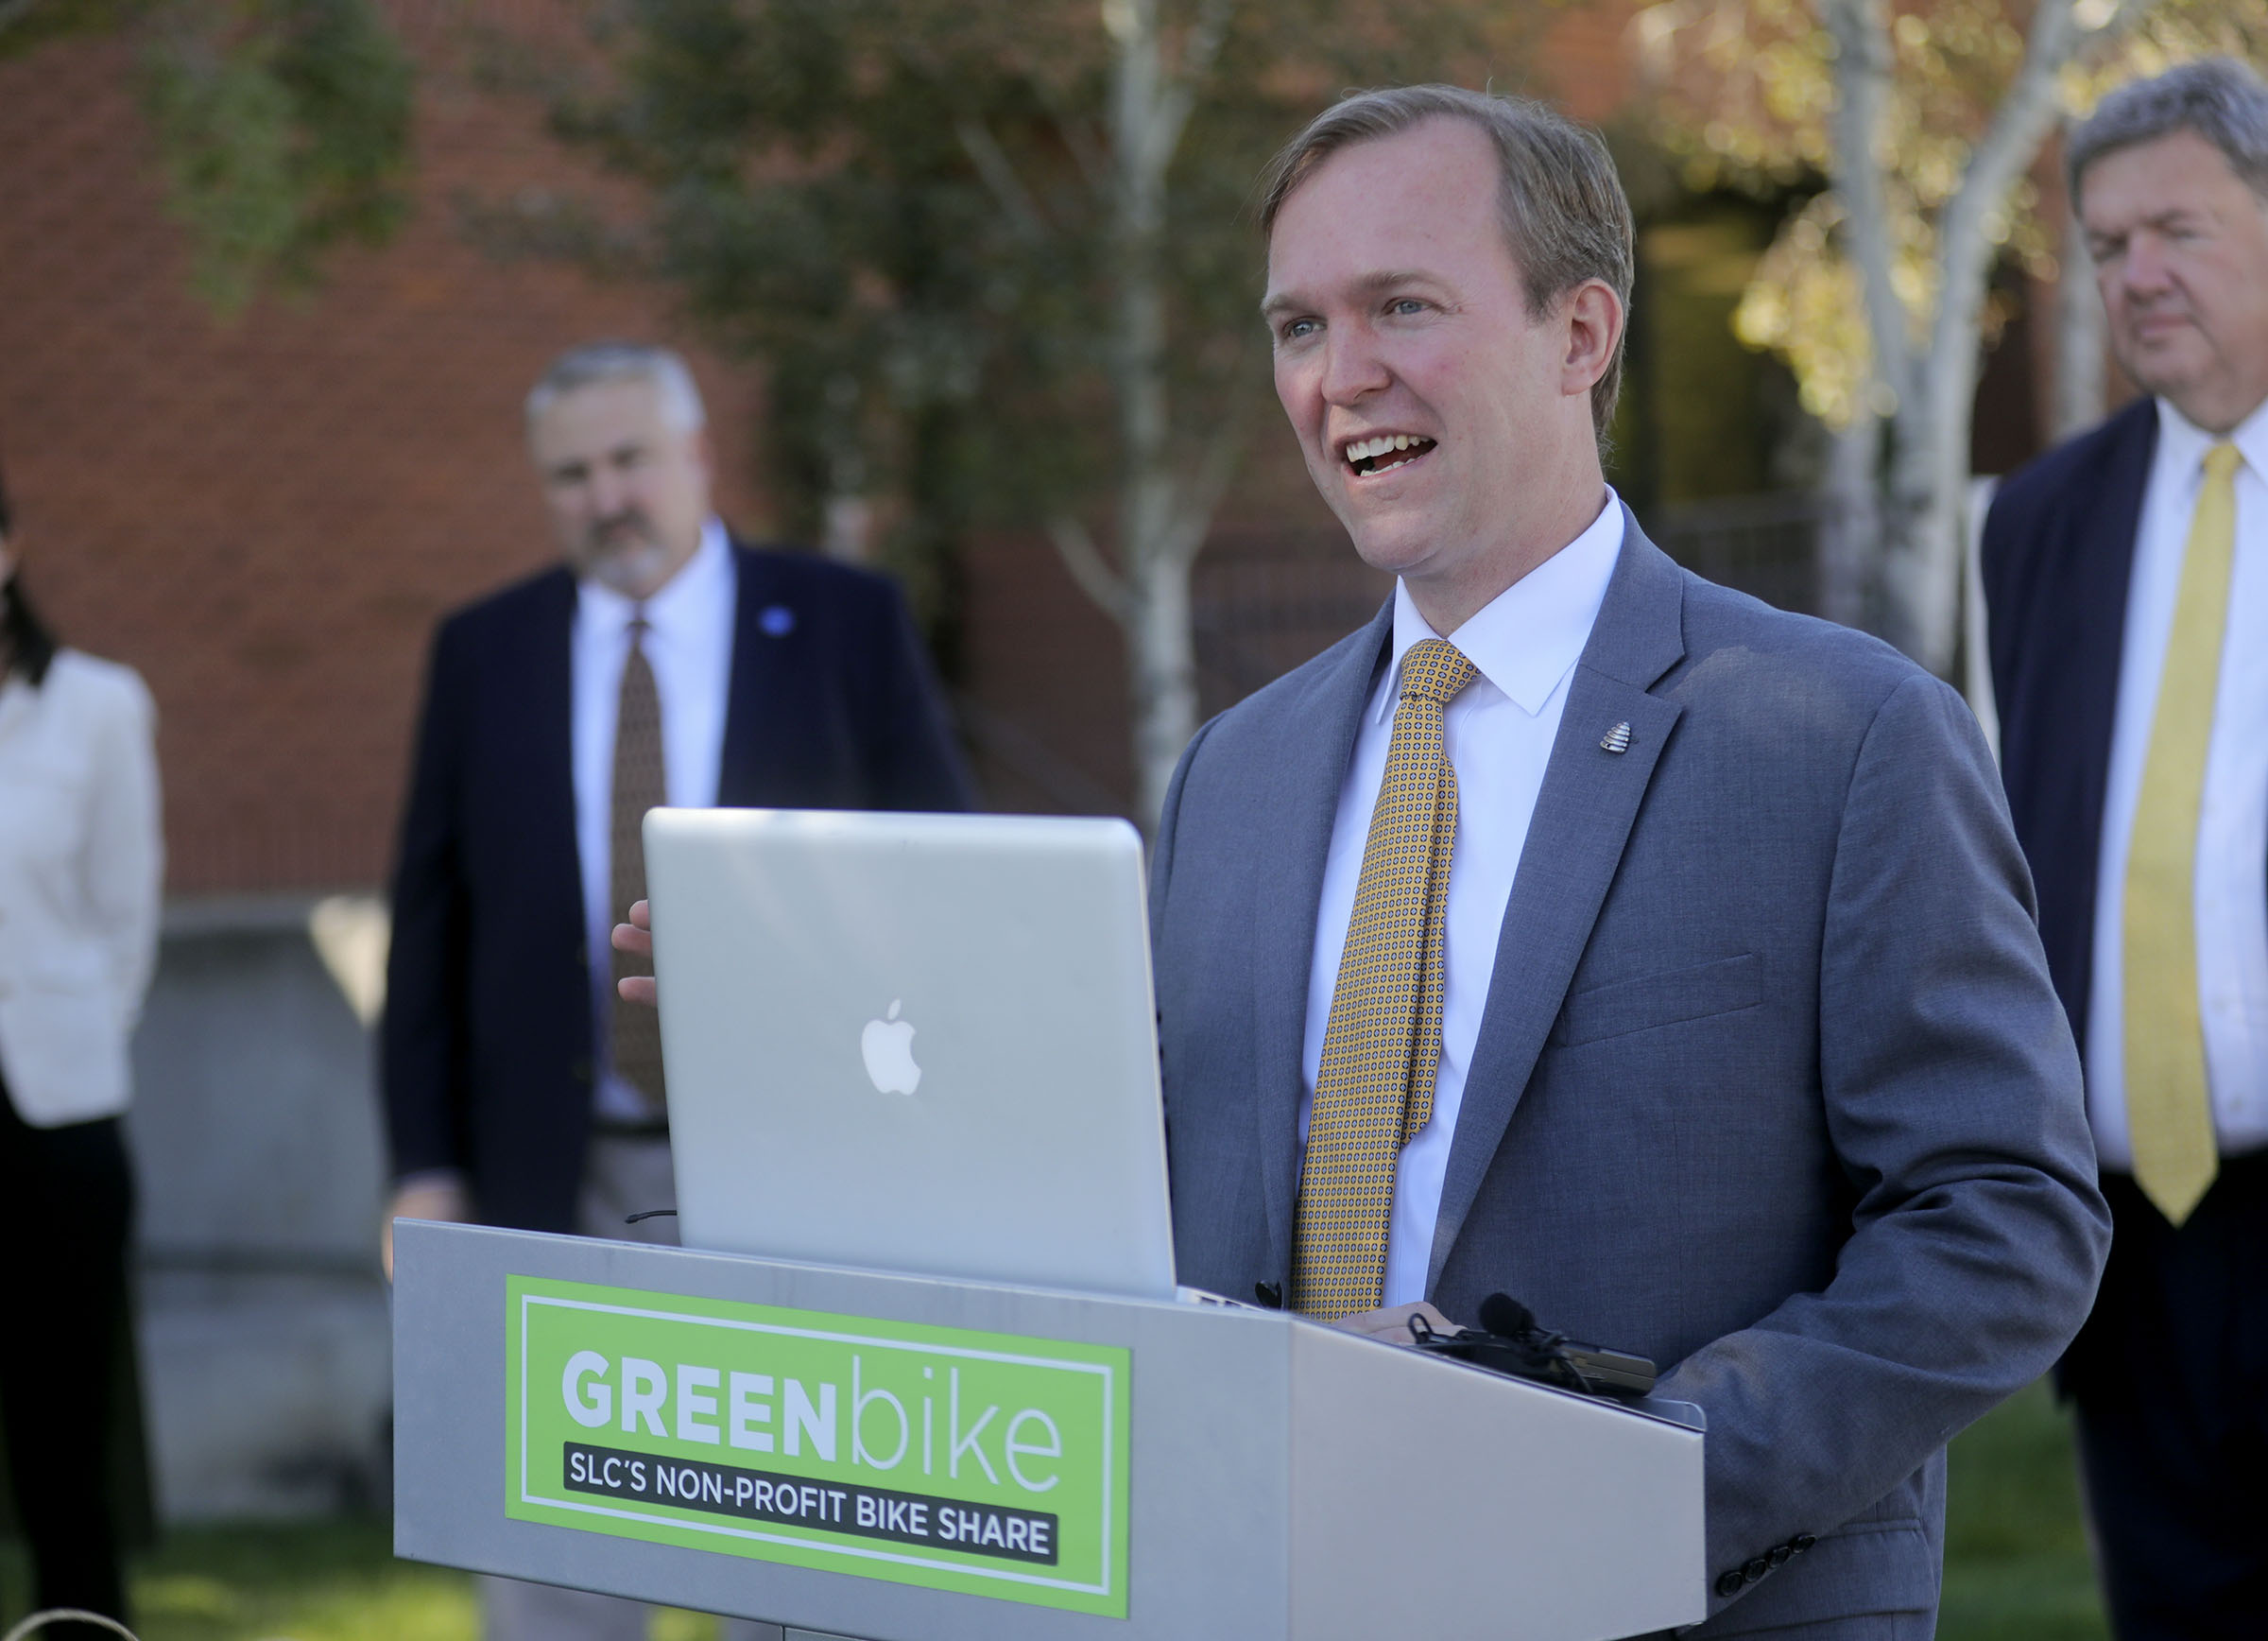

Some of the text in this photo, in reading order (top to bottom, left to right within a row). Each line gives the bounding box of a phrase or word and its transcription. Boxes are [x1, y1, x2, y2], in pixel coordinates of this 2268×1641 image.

[569, 1451, 1051, 1556] SLC'S NON-PROFIT BIKE SHARE
